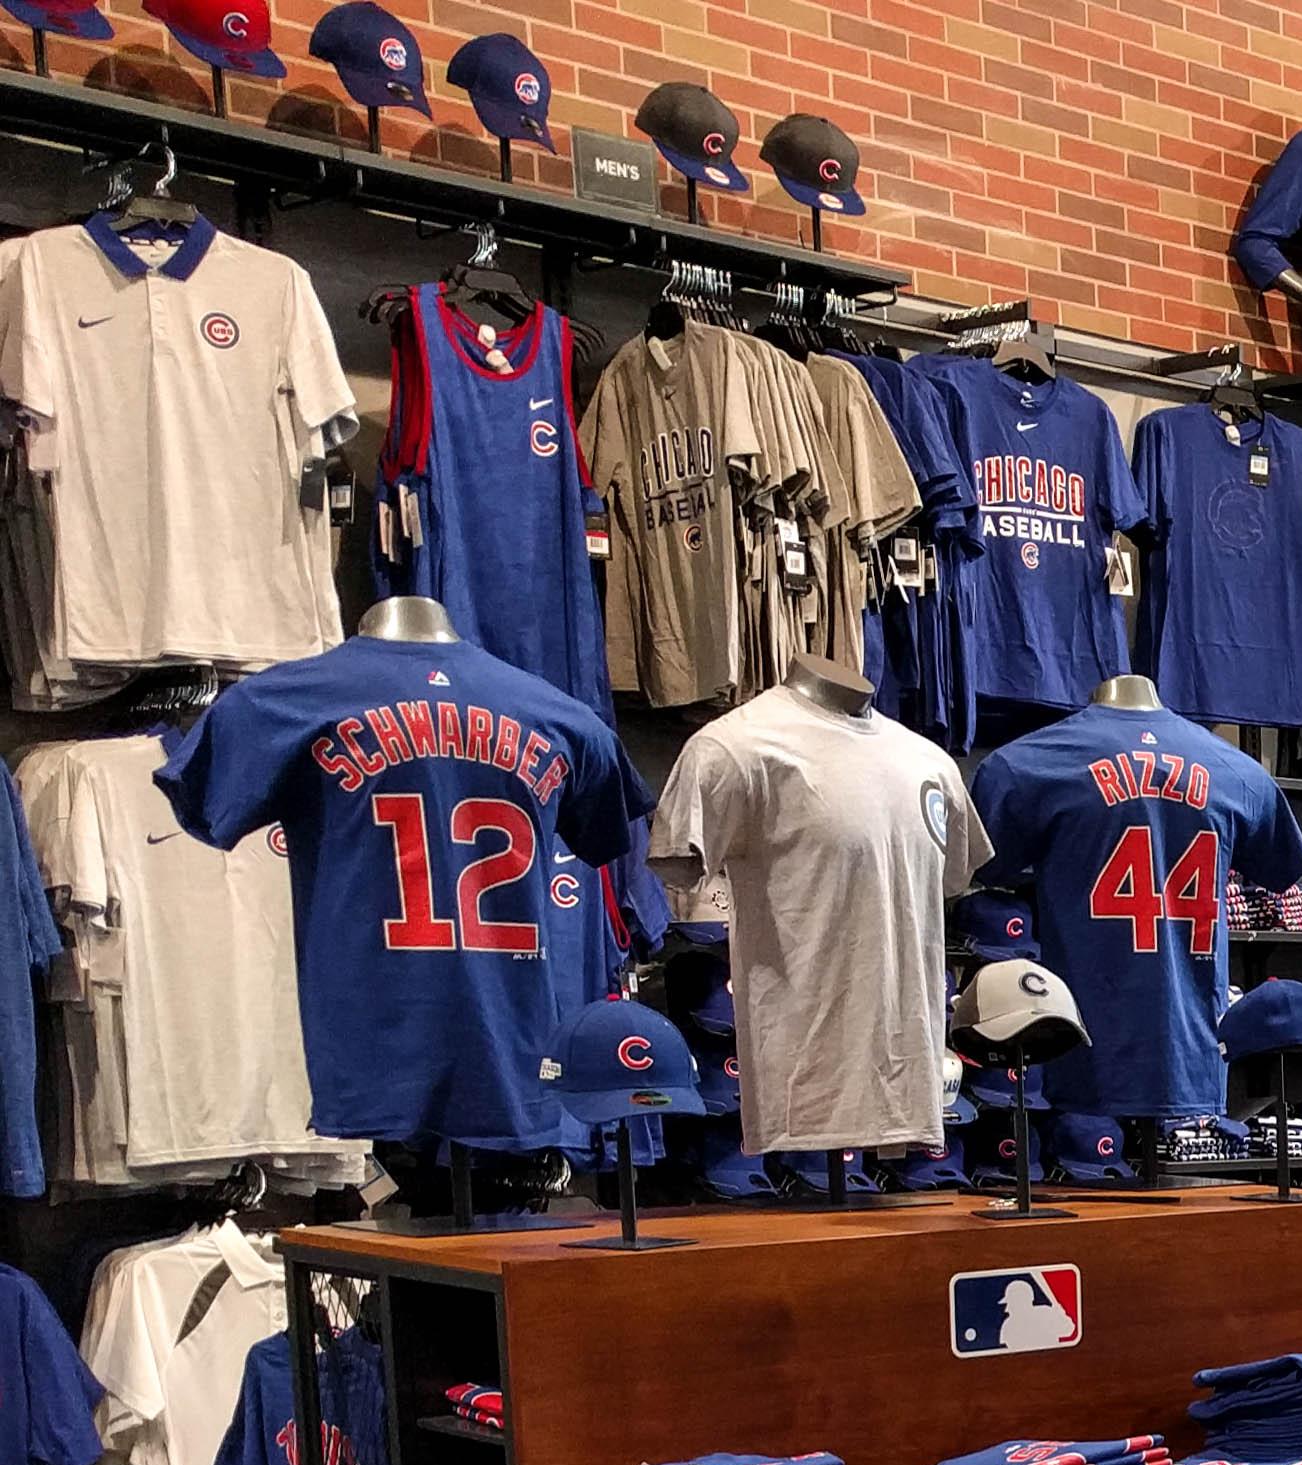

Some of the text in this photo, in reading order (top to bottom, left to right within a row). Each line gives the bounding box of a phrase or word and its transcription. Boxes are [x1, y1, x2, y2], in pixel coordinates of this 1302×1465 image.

[595, 157, 640, 181] MEN'S
[530, 420, 559, 457] C
[312, 700, 569, 806] SCHWARBER
[1088, 750, 1210, 810] RIZZO
[372, 793, 539, 952] 12
[1090, 825, 1219, 955] 44
[618, 1035, 654, 1071] C
